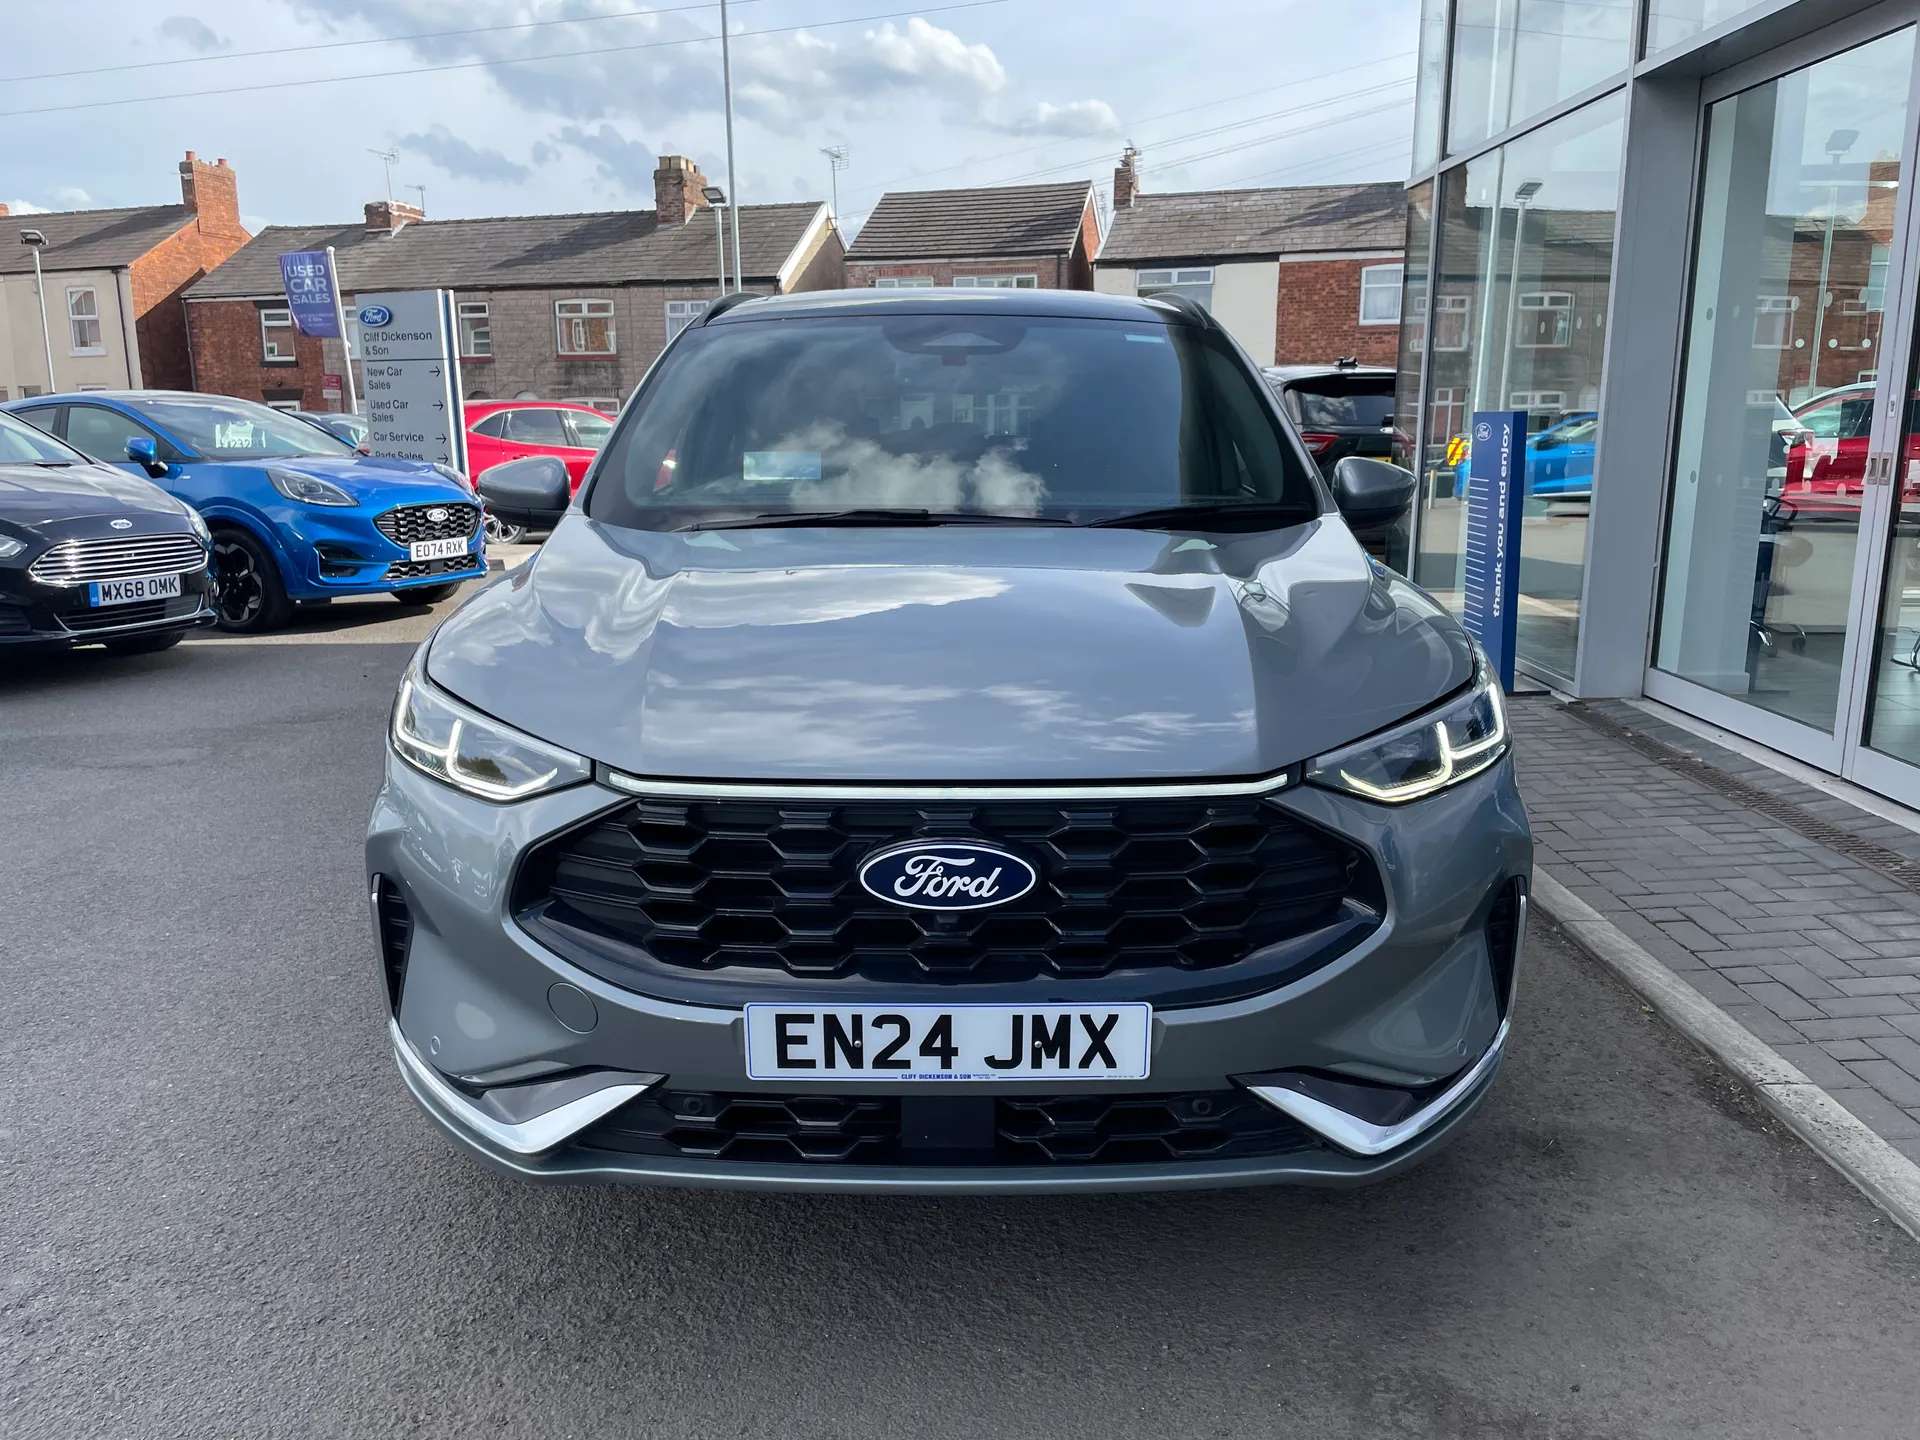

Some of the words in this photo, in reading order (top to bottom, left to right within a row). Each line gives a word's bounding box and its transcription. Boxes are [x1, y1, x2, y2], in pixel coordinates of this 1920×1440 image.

[287, 264, 325, 277] USED
[290, 277, 328, 293] CAR
[292, 293, 331, 305] SALES
[363, 331, 380, 343] Cliff
[381, 331, 433, 343] Dickenson
[365, 346, 371, 356] &
[372, 345, 389, 356] Son
[367, 367, 385, 377] New
[386, 366, 403, 377] Car
[368, 380, 391, 390] Sales
[370, 400, 391, 410] Used
[392, 399, 409, 409] Car
[371, 412, 395, 422] Sales
[373, 431, 388, 441] Car
[389, 431, 425, 442] Service
[398, 451, 424, 461] Sales
[1500, 423, 1510, 478] enjoy
[1496, 522, 1504, 559] you
[415, 542, 444, 558] EO74
[446, 539, 464, 555] RXK
[101, 581, 145, 602] MX68
[149, 576, 178, 596] OMK
[1493, 561, 1502, 618] thank
[893, 855, 1003, 898] Ford
[774, 1013, 959, 1070] EN24
[983, 1013, 1121, 1070] JMX
